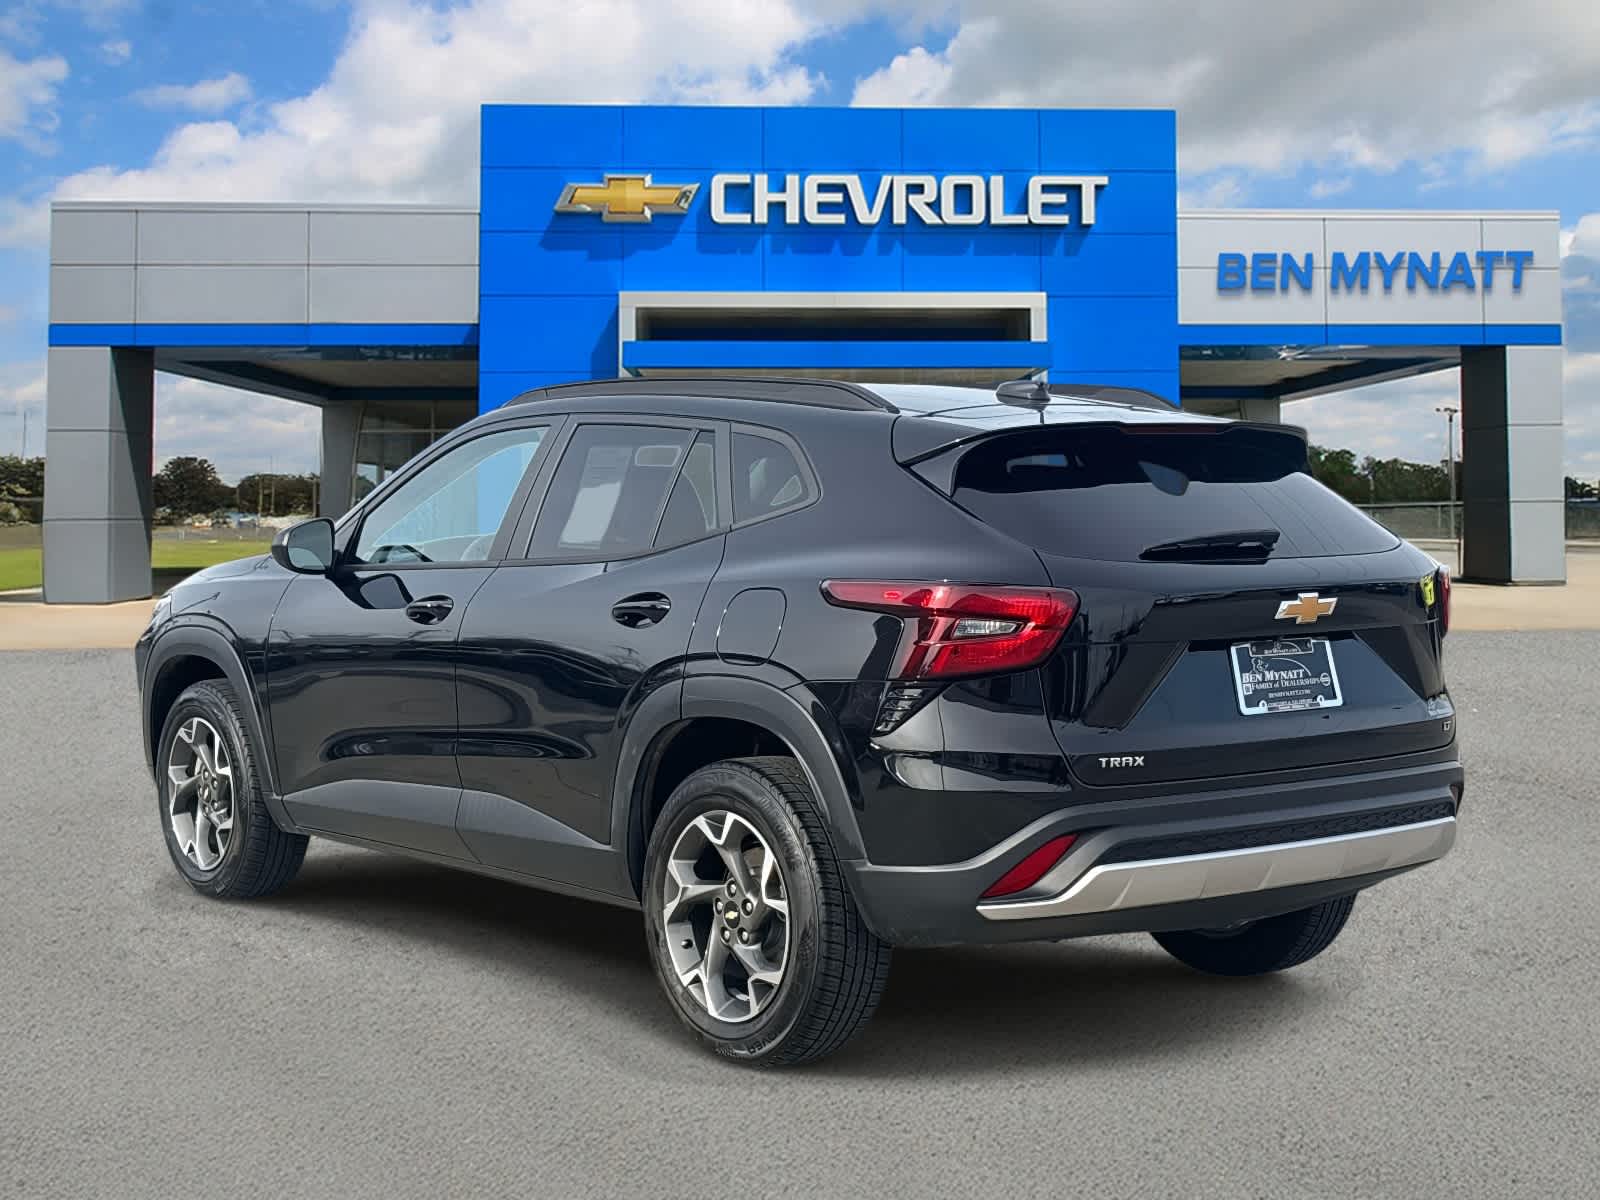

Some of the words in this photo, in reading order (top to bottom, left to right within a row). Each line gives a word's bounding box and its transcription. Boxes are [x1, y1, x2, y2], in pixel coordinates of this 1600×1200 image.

[710, 173, 1109, 225] CHEVROLET
[1216, 251, 1313, 292] BEN
[1329, 250, 1535, 292] MYNATT
[1242, 672, 1263, 684] BEN
[1264, 668, 1305, 682] MYNATT
[1098, 756, 1145, 768] TRAX
